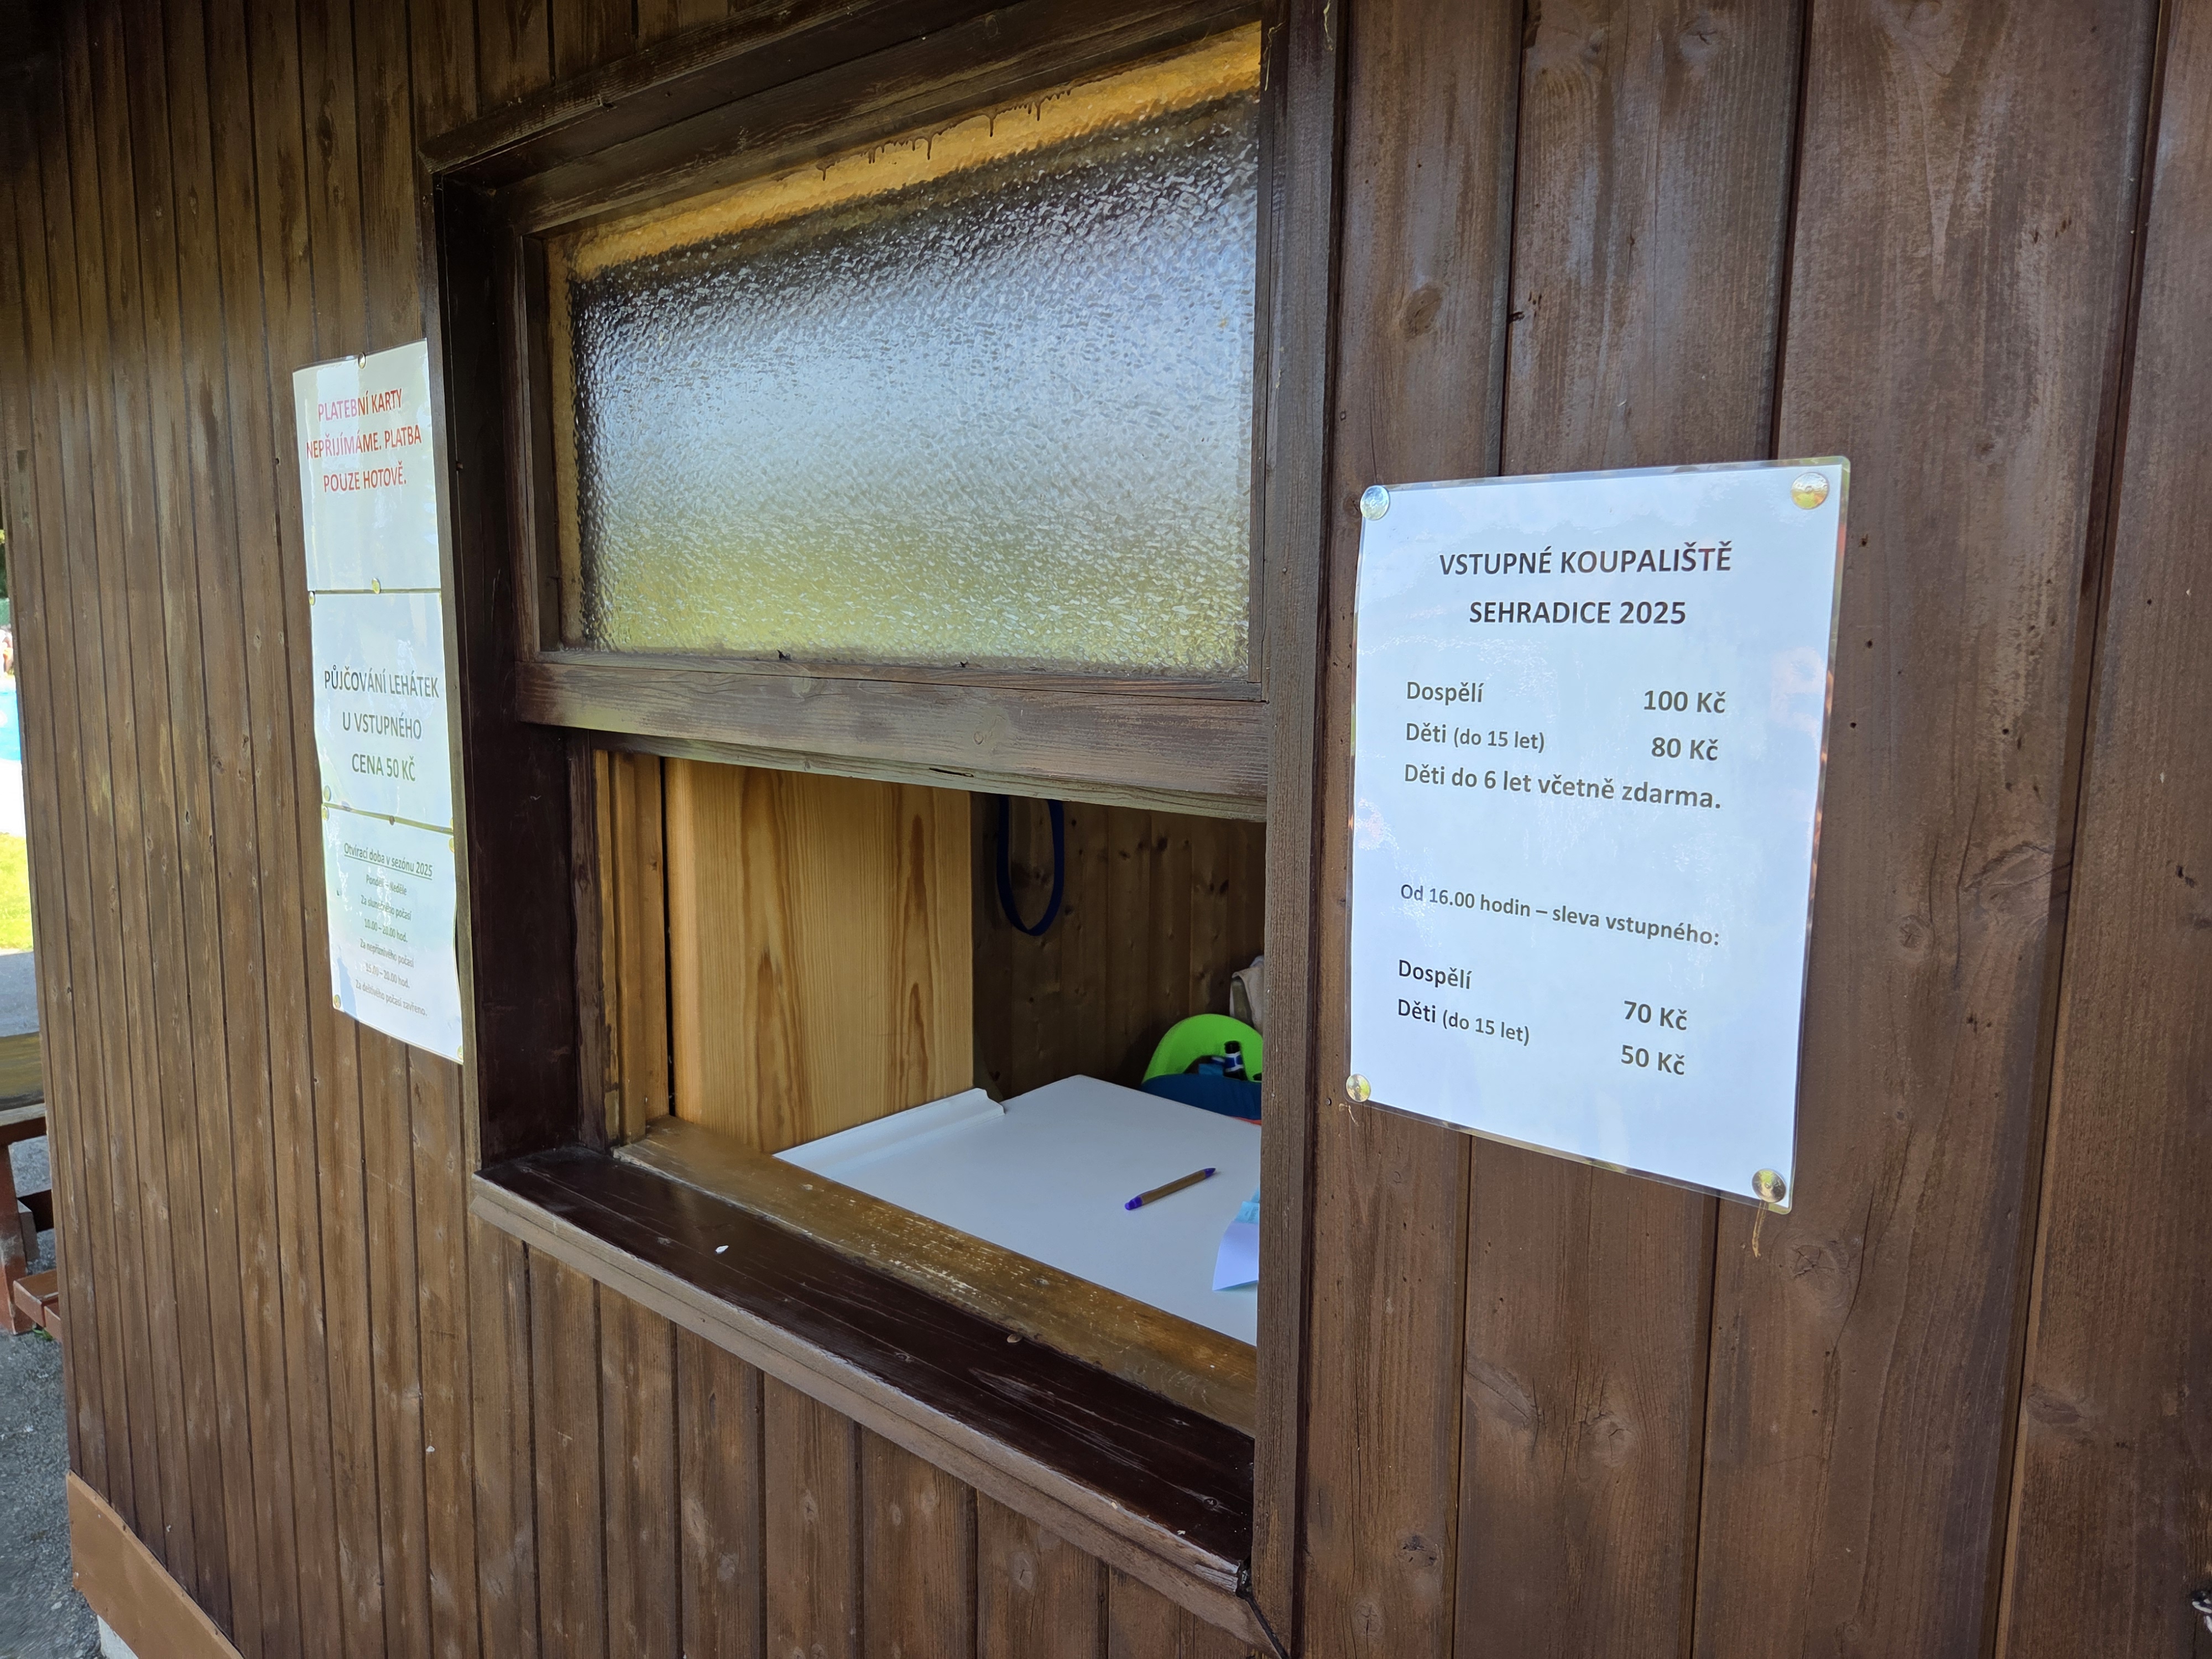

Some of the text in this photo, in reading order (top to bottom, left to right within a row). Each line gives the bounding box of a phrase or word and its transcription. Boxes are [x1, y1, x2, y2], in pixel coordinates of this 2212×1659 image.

[318, 388, 402, 421] PLATEBNÍ KARTY
[306, 425, 421, 460] NEPŘIJÍMÁME. PLATBA
[324, 461, 406, 493] POUZE HOTOVĚ.
[1439, 541, 1733, 576] VSTUPNÉ KOUPALIŠTĚ
[1469, 601, 1686, 624] SEHRADICE 2025
[325, 665, 439, 698] PŮJČOVÁNÍ LEHÁTEK
[1406, 681, 1483, 706] Dospělí
[1644, 690, 1725, 714] 100 Kč
[343, 712, 422, 740] U VSTUPNÉHO
[1405, 723, 1545, 753] Děti (do 15 let)
[1651, 737, 1718, 761] 80 Kč
[352, 753, 416, 782] CENA 50 KČ
[1405, 764, 1721, 810] Děti do 6 let včetně zdarma.
[344, 842, 432, 877] Otvírací doba v sezónu 2025
[395, 907, 412, 921] počasí
[1400, 883, 1423, 902] Od
[1429, 888, 1475, 909] 16.00
[1480, 894, 1530, 917] hodin
[1552, 906, 1599, 928] sleva
[1605, 915, 1720, 946] vstupného:
[398, 953, 414, 968] počasí
[1398, 959, 1472, 990] Dospělí
[385, 994, 402, 1009] počasí
[1623, 1000, 1688, 1031] 70 Kč
[1397, 998, 1530, 1046] Děti (do 15 let)
[1620, 1045, 1686, 1076] 50 Kč
